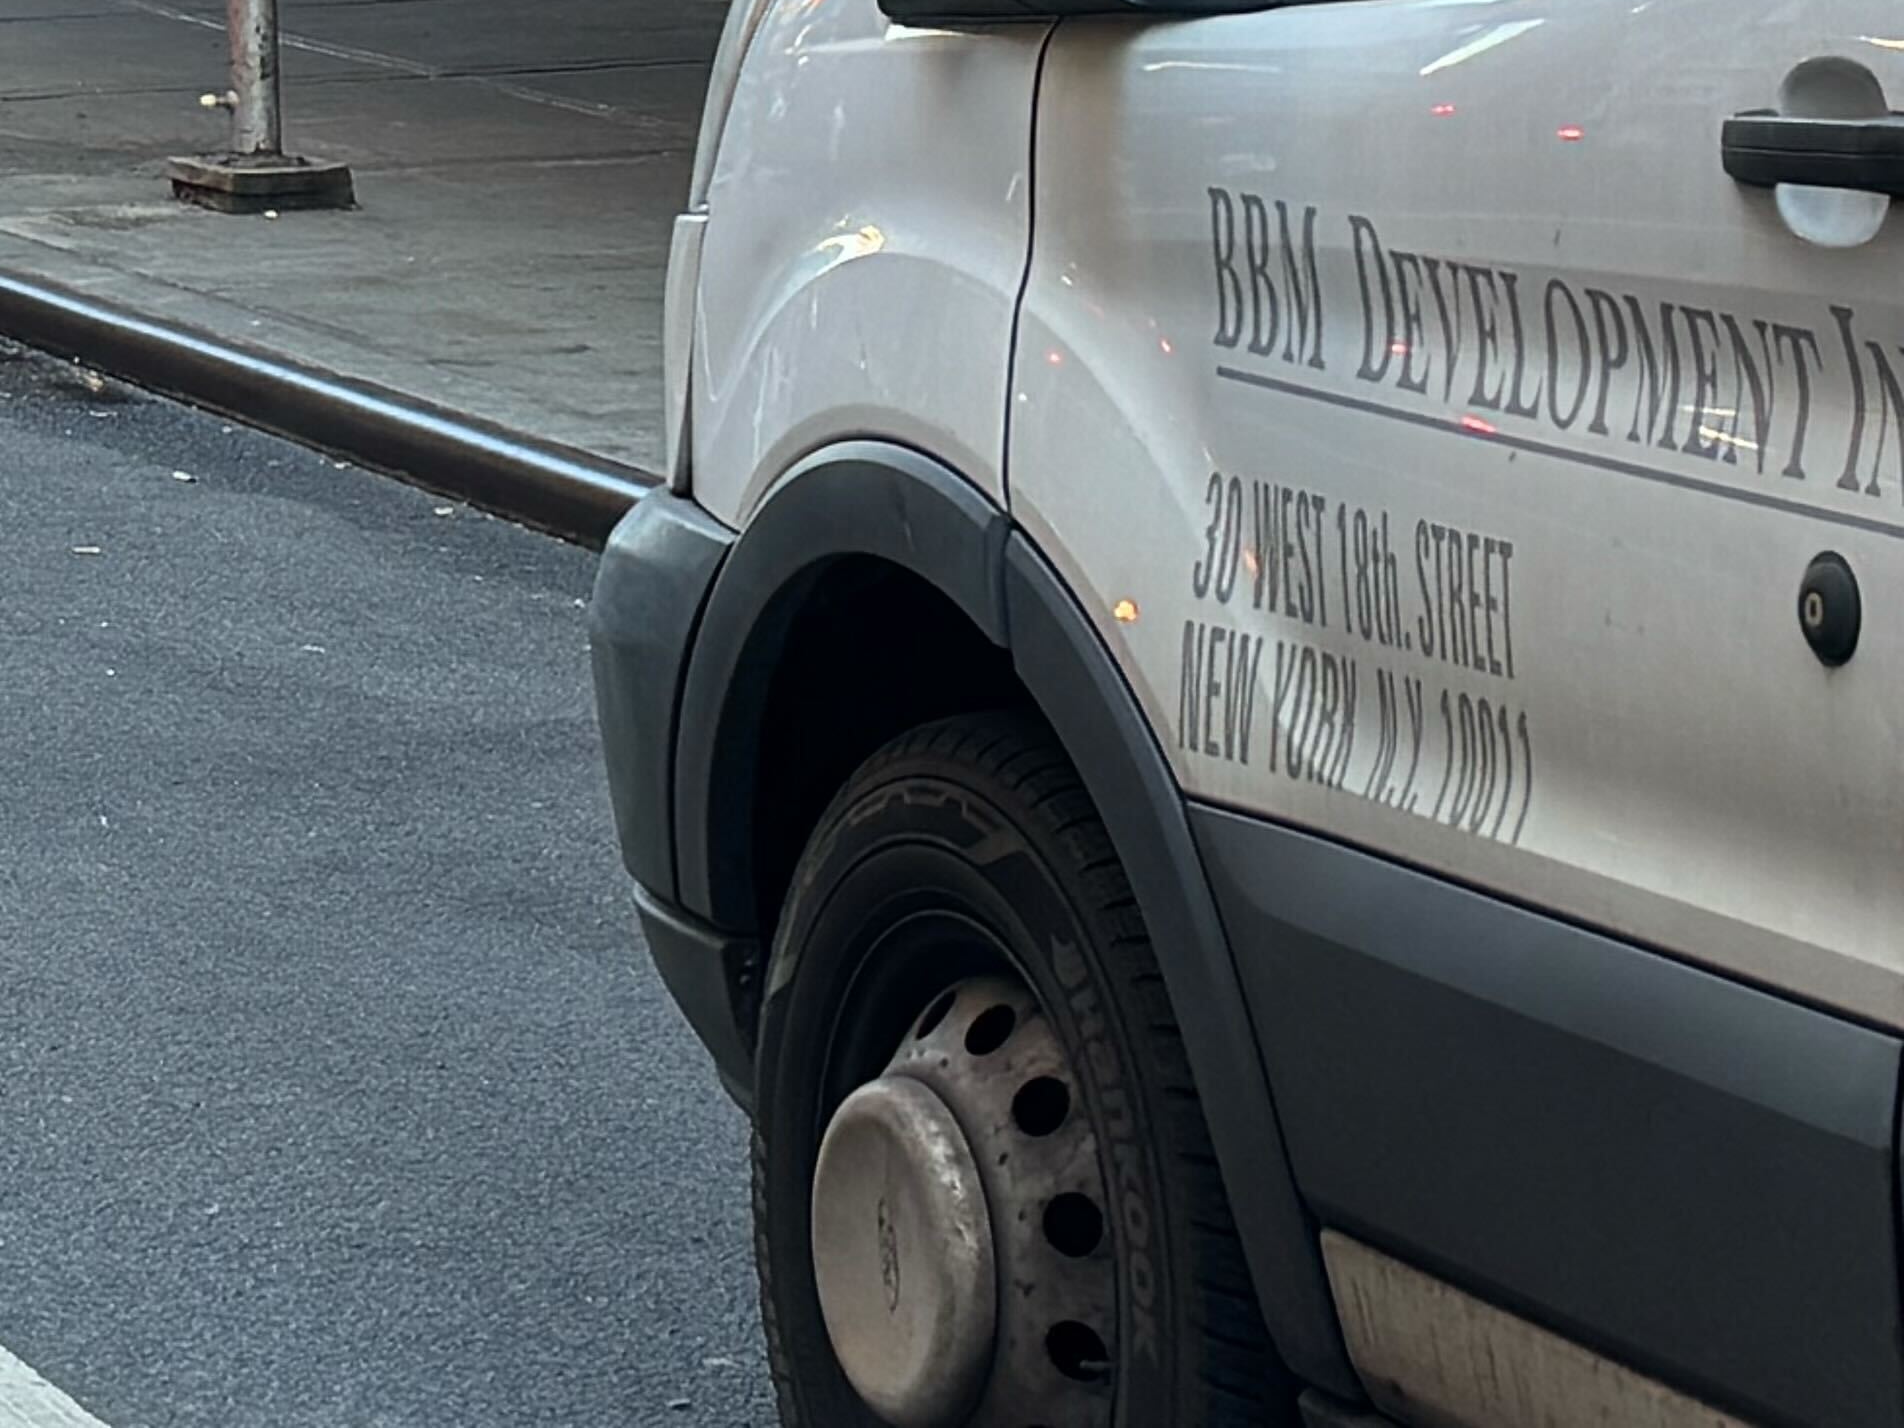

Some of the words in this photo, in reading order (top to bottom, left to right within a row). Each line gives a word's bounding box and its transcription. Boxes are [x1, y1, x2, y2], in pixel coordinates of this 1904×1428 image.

[1206, 186, 1326, 372] BBM
[1192, 471, 1244, 605] 30
[1252, 479, 1328, 629] WEST
[1414, 515, 1519, 681] STREET
[1177, 619, 1263, 764] NEW
[1268, 644, 1358, 794] YORK
[1429, 684, 1535, 848] 10011
